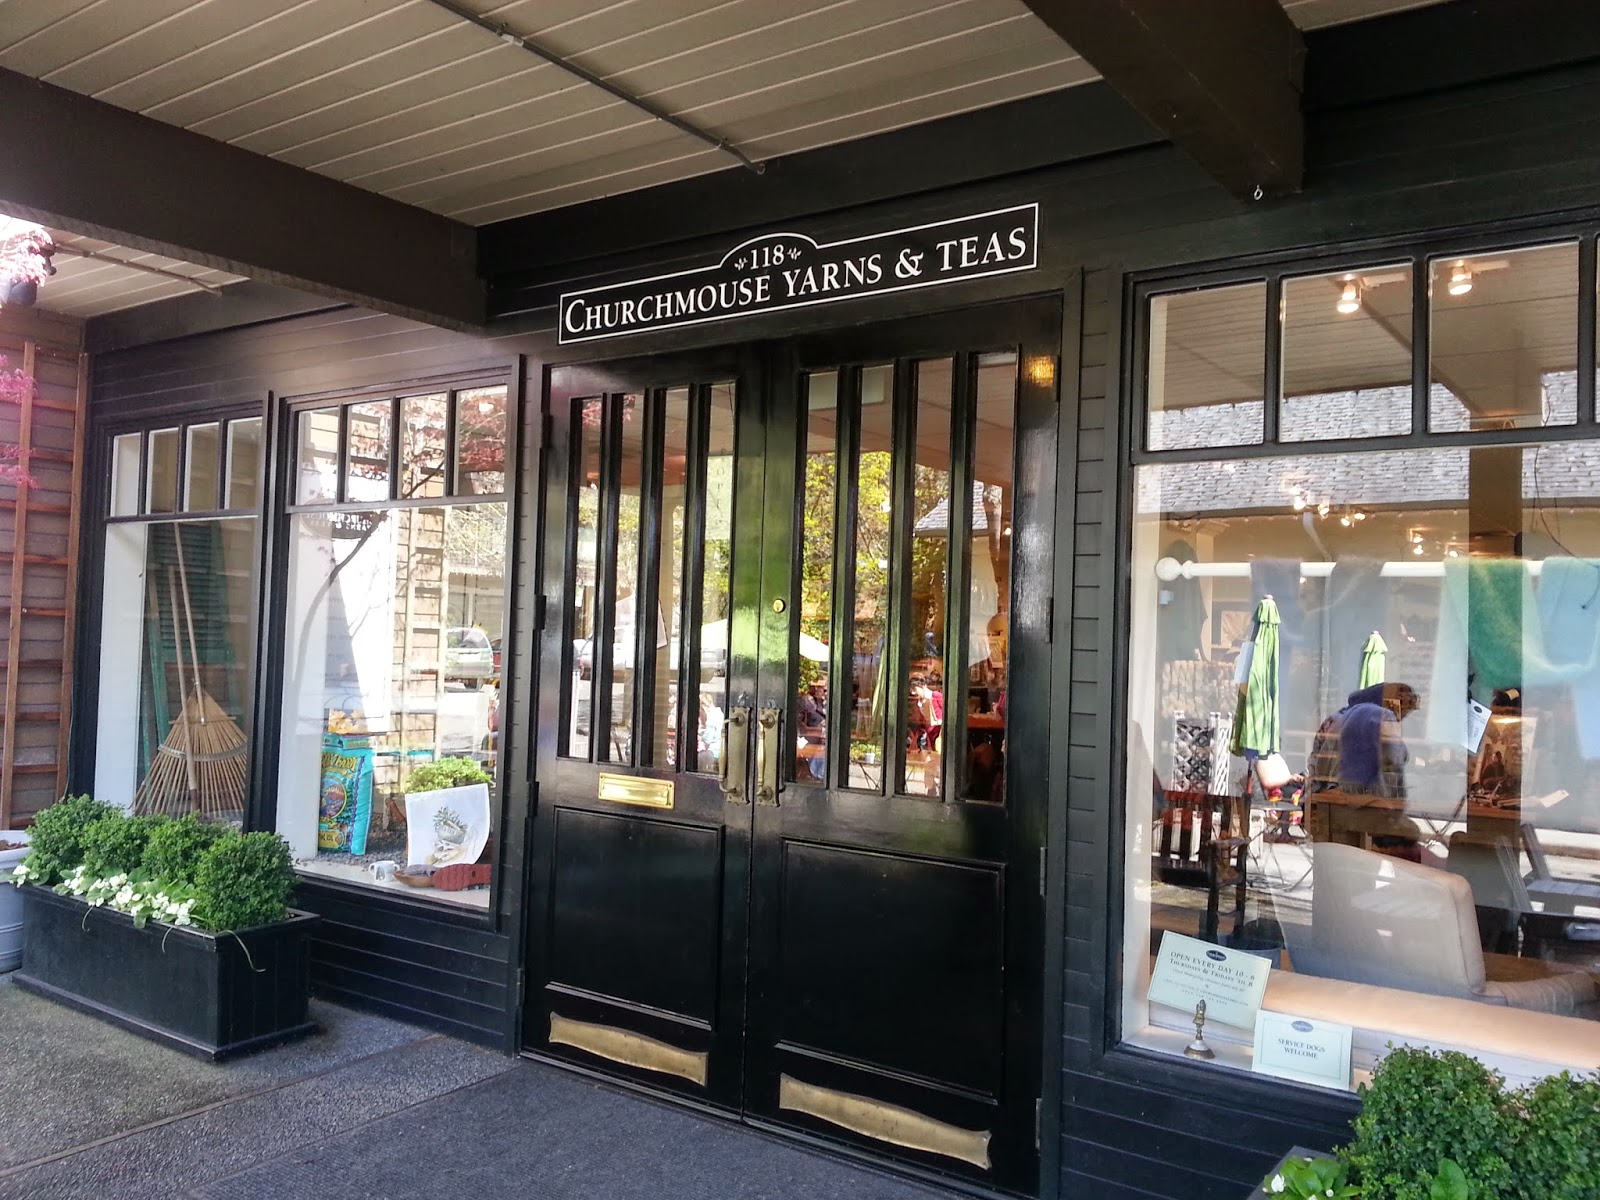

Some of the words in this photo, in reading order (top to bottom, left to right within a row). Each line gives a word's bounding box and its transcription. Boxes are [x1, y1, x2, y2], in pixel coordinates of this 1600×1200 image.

[750, 244, 785, 270] 118
[565, 274, 771, 334] CHURCHMOUSE
[782, 254, 883, 298] YARNS
[894, 247, 925, 279] &
[936, 226, 1028, 271] TEAS
[1170, 952, 1190, 962] OPEN
[1193, 958, 1216, 969] EVERY
[1218, 965, 1233, 974] DAY
[1278, 1038, 1305, 1049] SERVICE
[1306, 1044, 1326, 1053] DOGS
[1284, 1047, 1317, 1059] WELCOME
